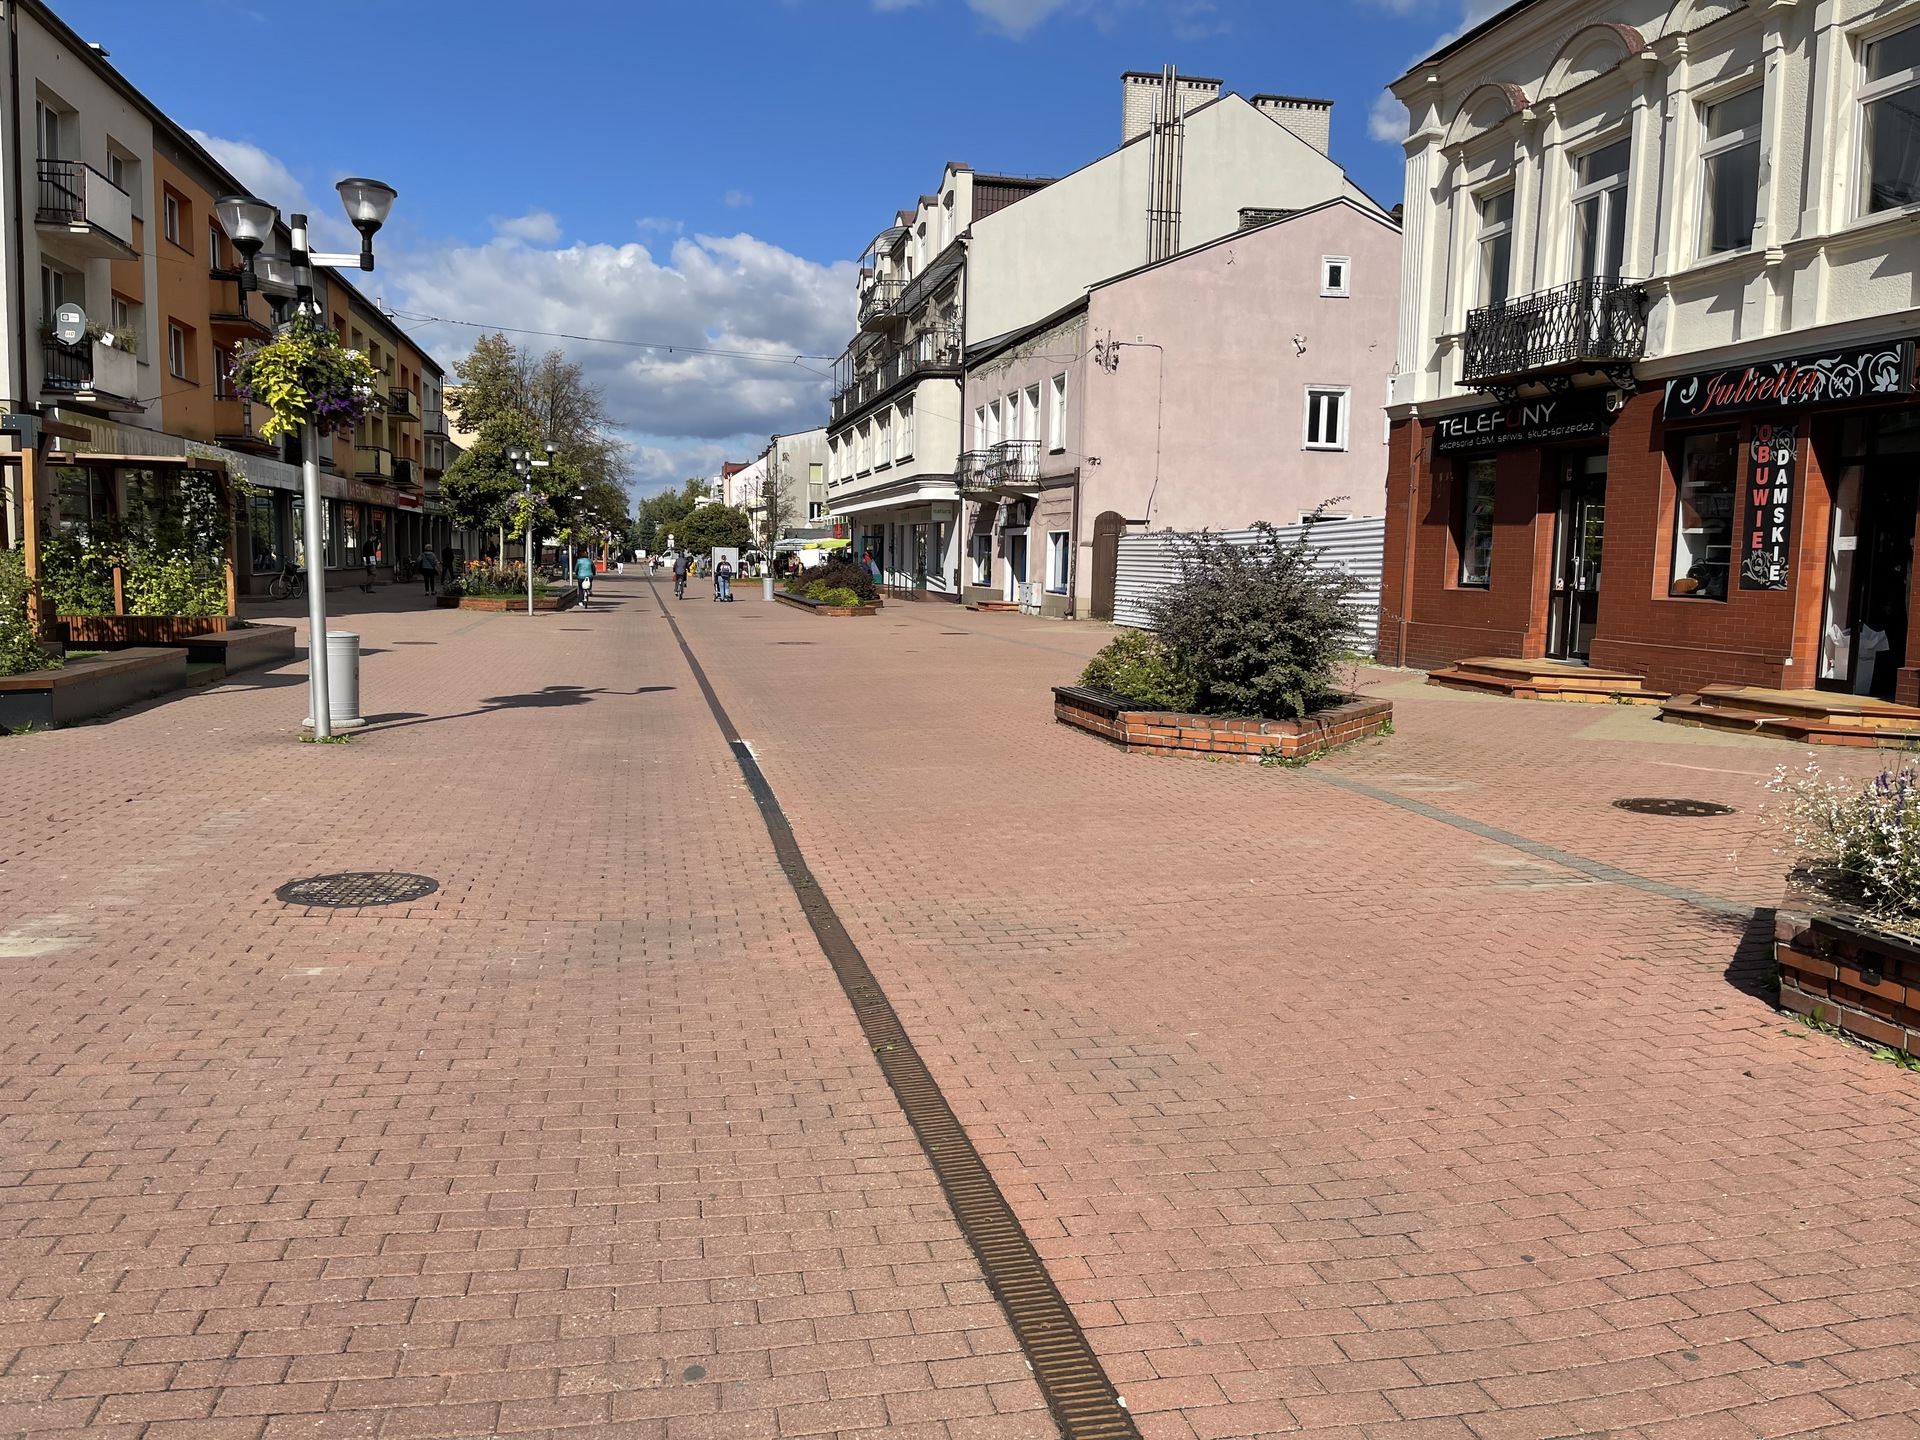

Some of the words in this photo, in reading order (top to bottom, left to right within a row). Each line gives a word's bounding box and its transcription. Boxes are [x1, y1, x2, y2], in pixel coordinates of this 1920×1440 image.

[1691, 367, 1821, 416] Julietta
[1751, 424, 1773, 549] OBUWIE
[1769, 449, 1790, 581] DAMSKIE
